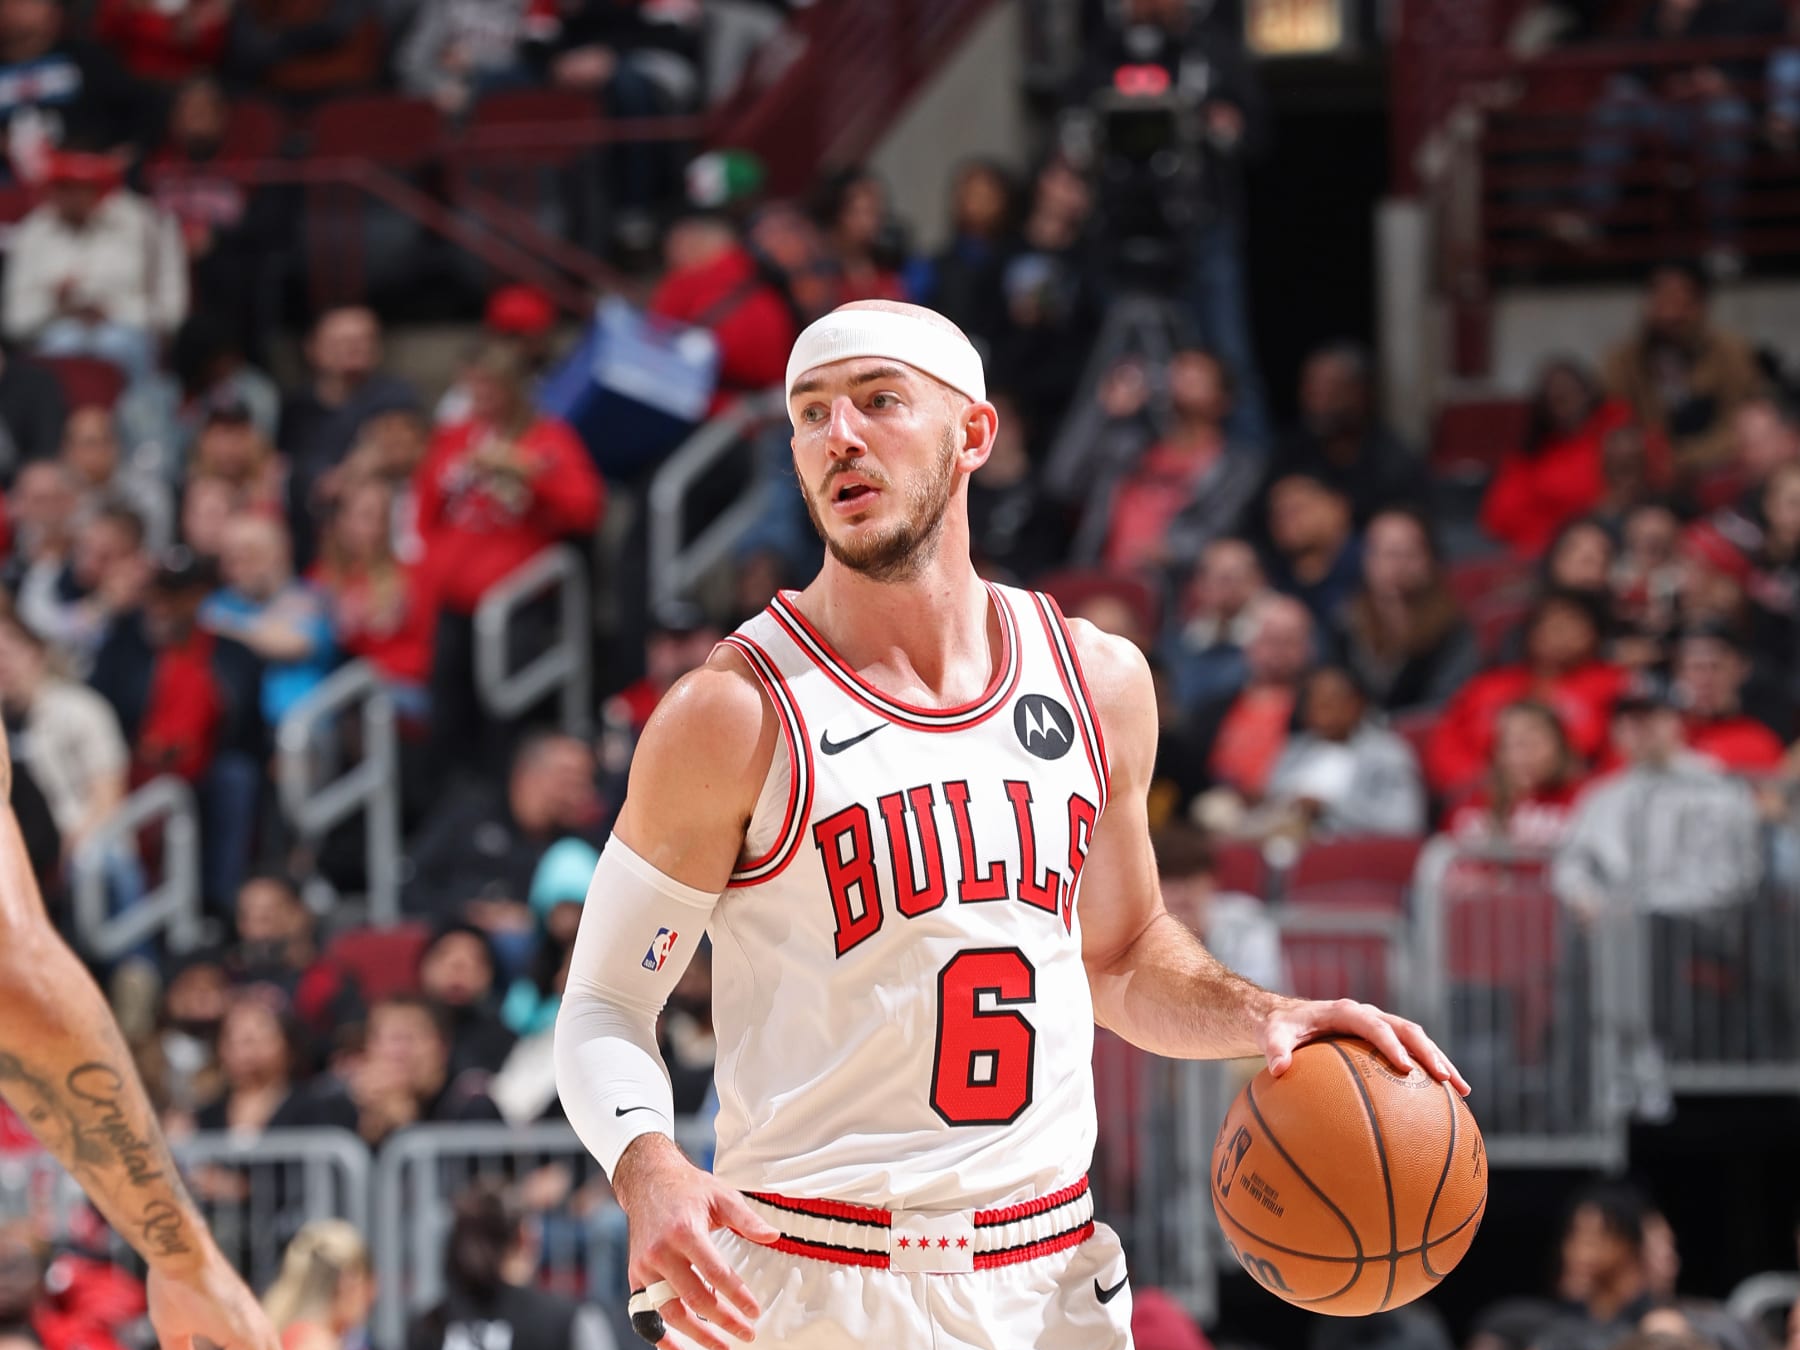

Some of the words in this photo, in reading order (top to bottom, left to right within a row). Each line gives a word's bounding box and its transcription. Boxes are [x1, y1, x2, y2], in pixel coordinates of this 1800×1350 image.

[813, 779, 1097, 960] BULLS
[643, 959, 656, 969] NBA
[929, 946, 1036, 1127] 6
[67, 1062, 163, 1186] Crystal
